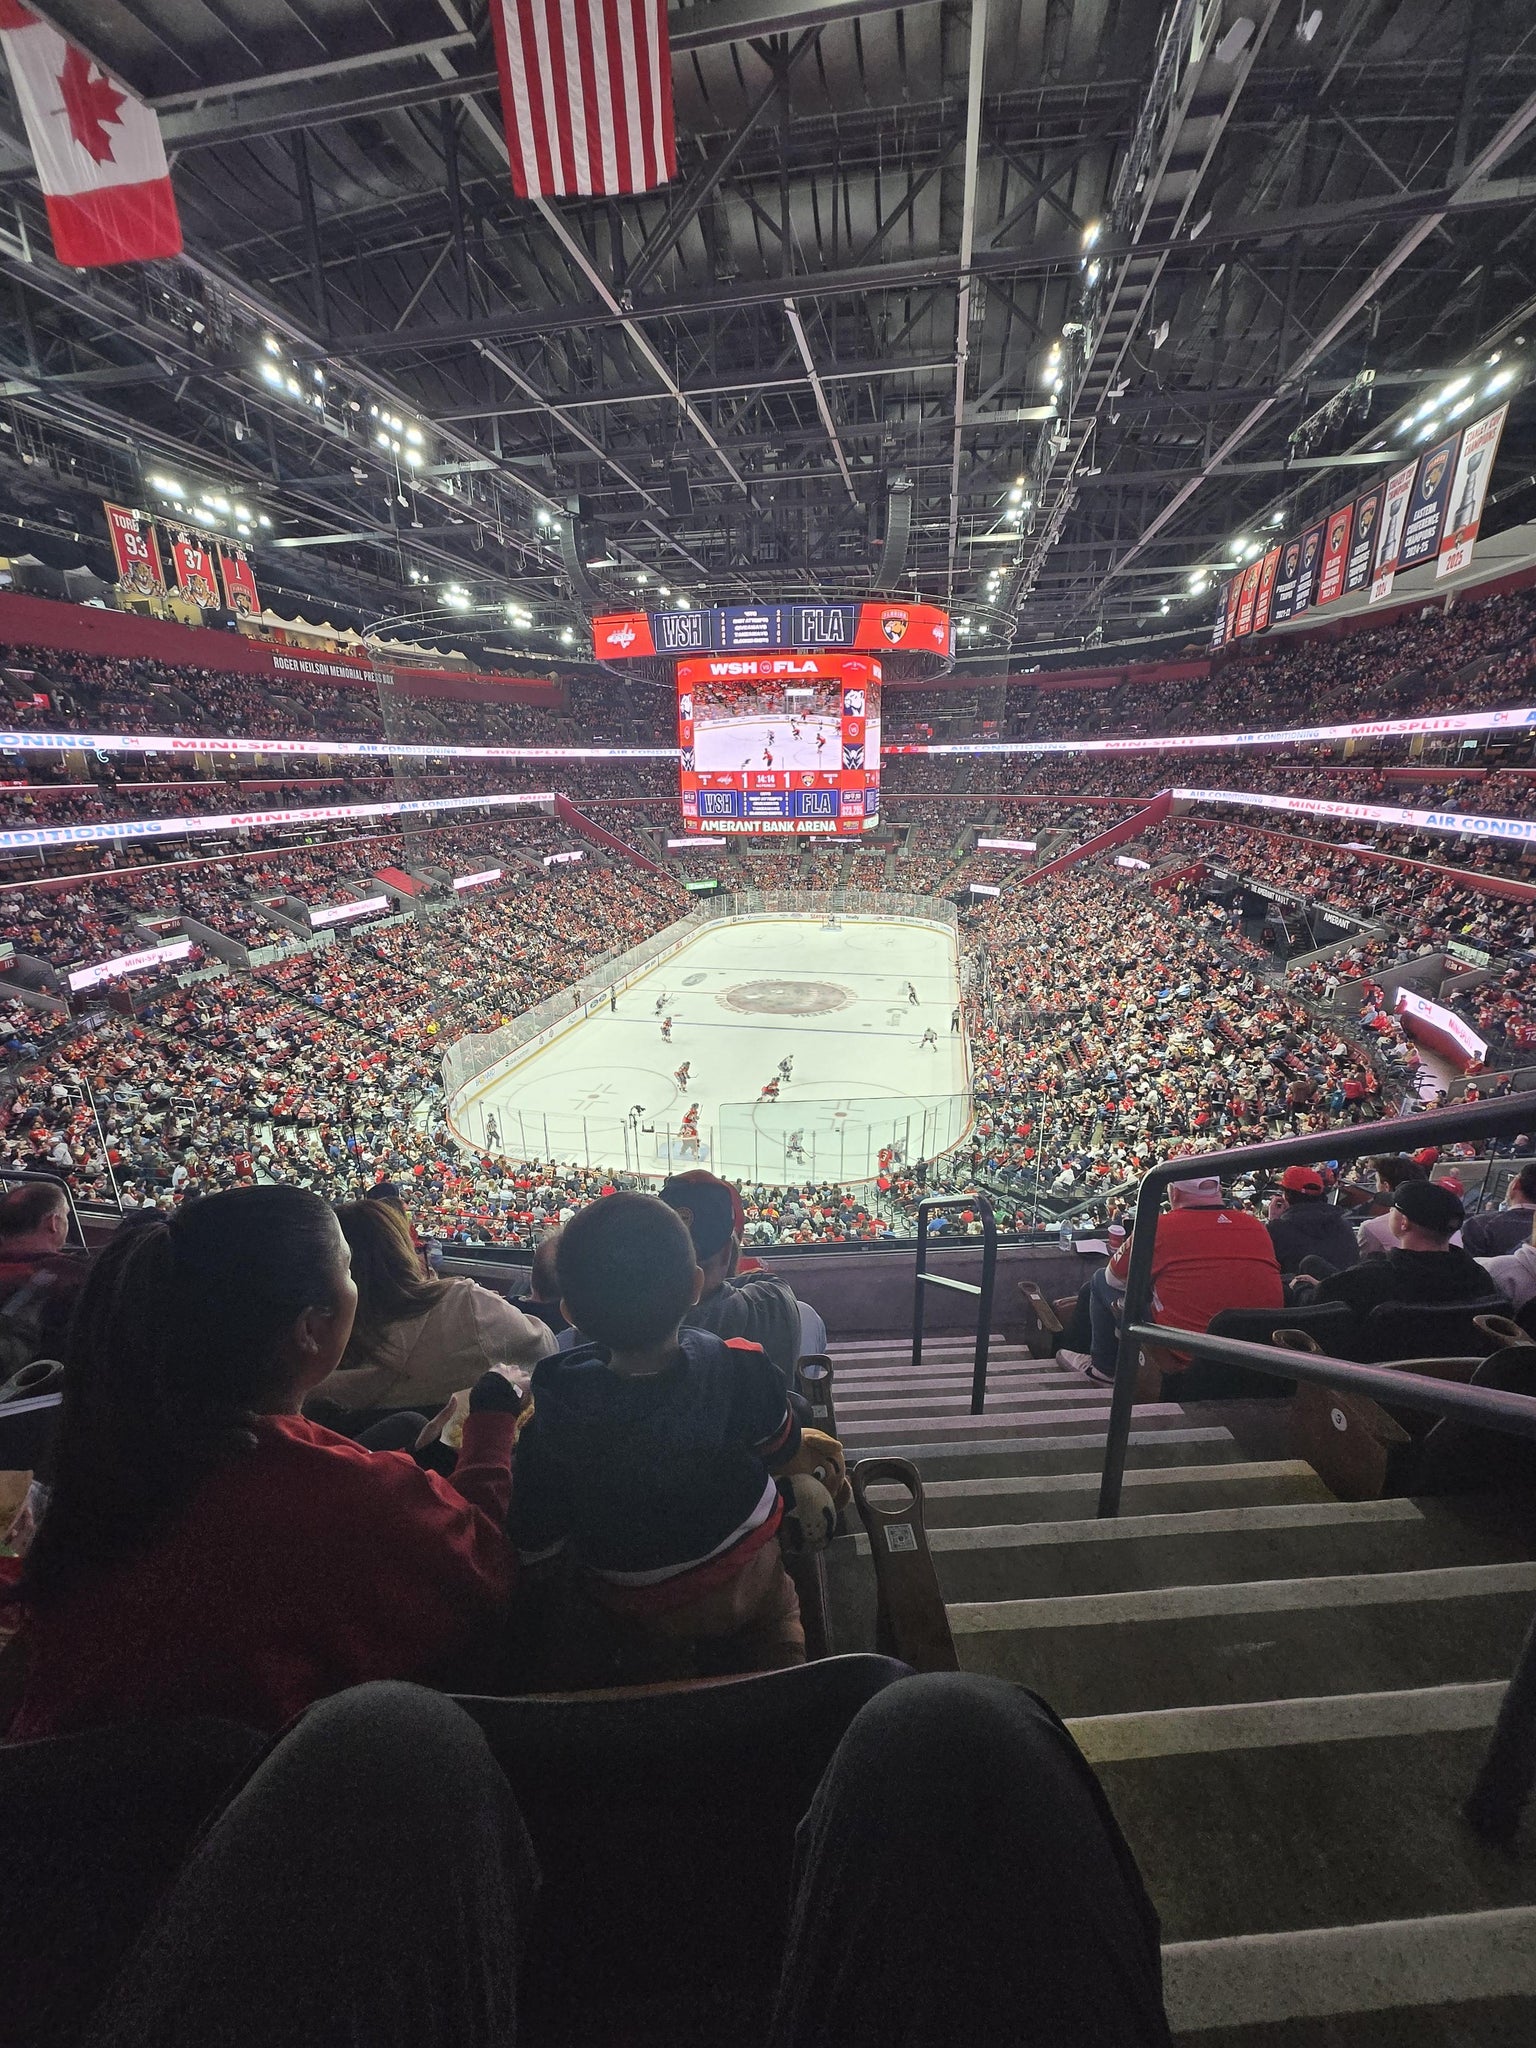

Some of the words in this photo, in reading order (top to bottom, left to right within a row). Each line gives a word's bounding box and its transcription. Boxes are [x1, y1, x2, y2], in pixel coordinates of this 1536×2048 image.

[124, 532, 148, 558] 93
[184, 548, 202, 570] 37
[662, 614, 702, 648] WSH
[802, 609, 845, 642] FLA
[272, 656, 299, 672] ROGER
[299, 660, 330, 676] NEILSON
[330, 665, 364, 681] MEMORIAL
[363, 670, 382, 683] PRESS
[382, 672, 395, 686] BOX
[710, 661, 758, 676] WSH
[773, 660, 819, 674] FLA
[1236, 734, 1254, 742] AIR
[1257, 730, 1320, 741] CONDITIONING
[358, 745, 378, 753] AIR
[383, 745, 457, 754] CONDITIONING
[741, 772, 748, 789] 1
[756, 774, 775, 784] 14:14
[783, 772, 790, 789] 1
[400, 801, 420, 810] AIR
[421, 797, 490, 809] CONDITIONING
[704, 793, 732, 814] WSH
[802, 793, 831, 814] FLA
[1208, 792, 1263, 804] CONDITIONING
[1288, 800, 1382, 818] MINI-SPLITS
[1426, 814, 1456, 827] AIR
[1462, 818, 1536, 837] CONDI
[700, 820, 761, 832] AMERANT
[762, 820, 794, 832] BANK
[796, 820, 837, 832] ARENA
[1323, 912, 1351, 930] AMERANT
